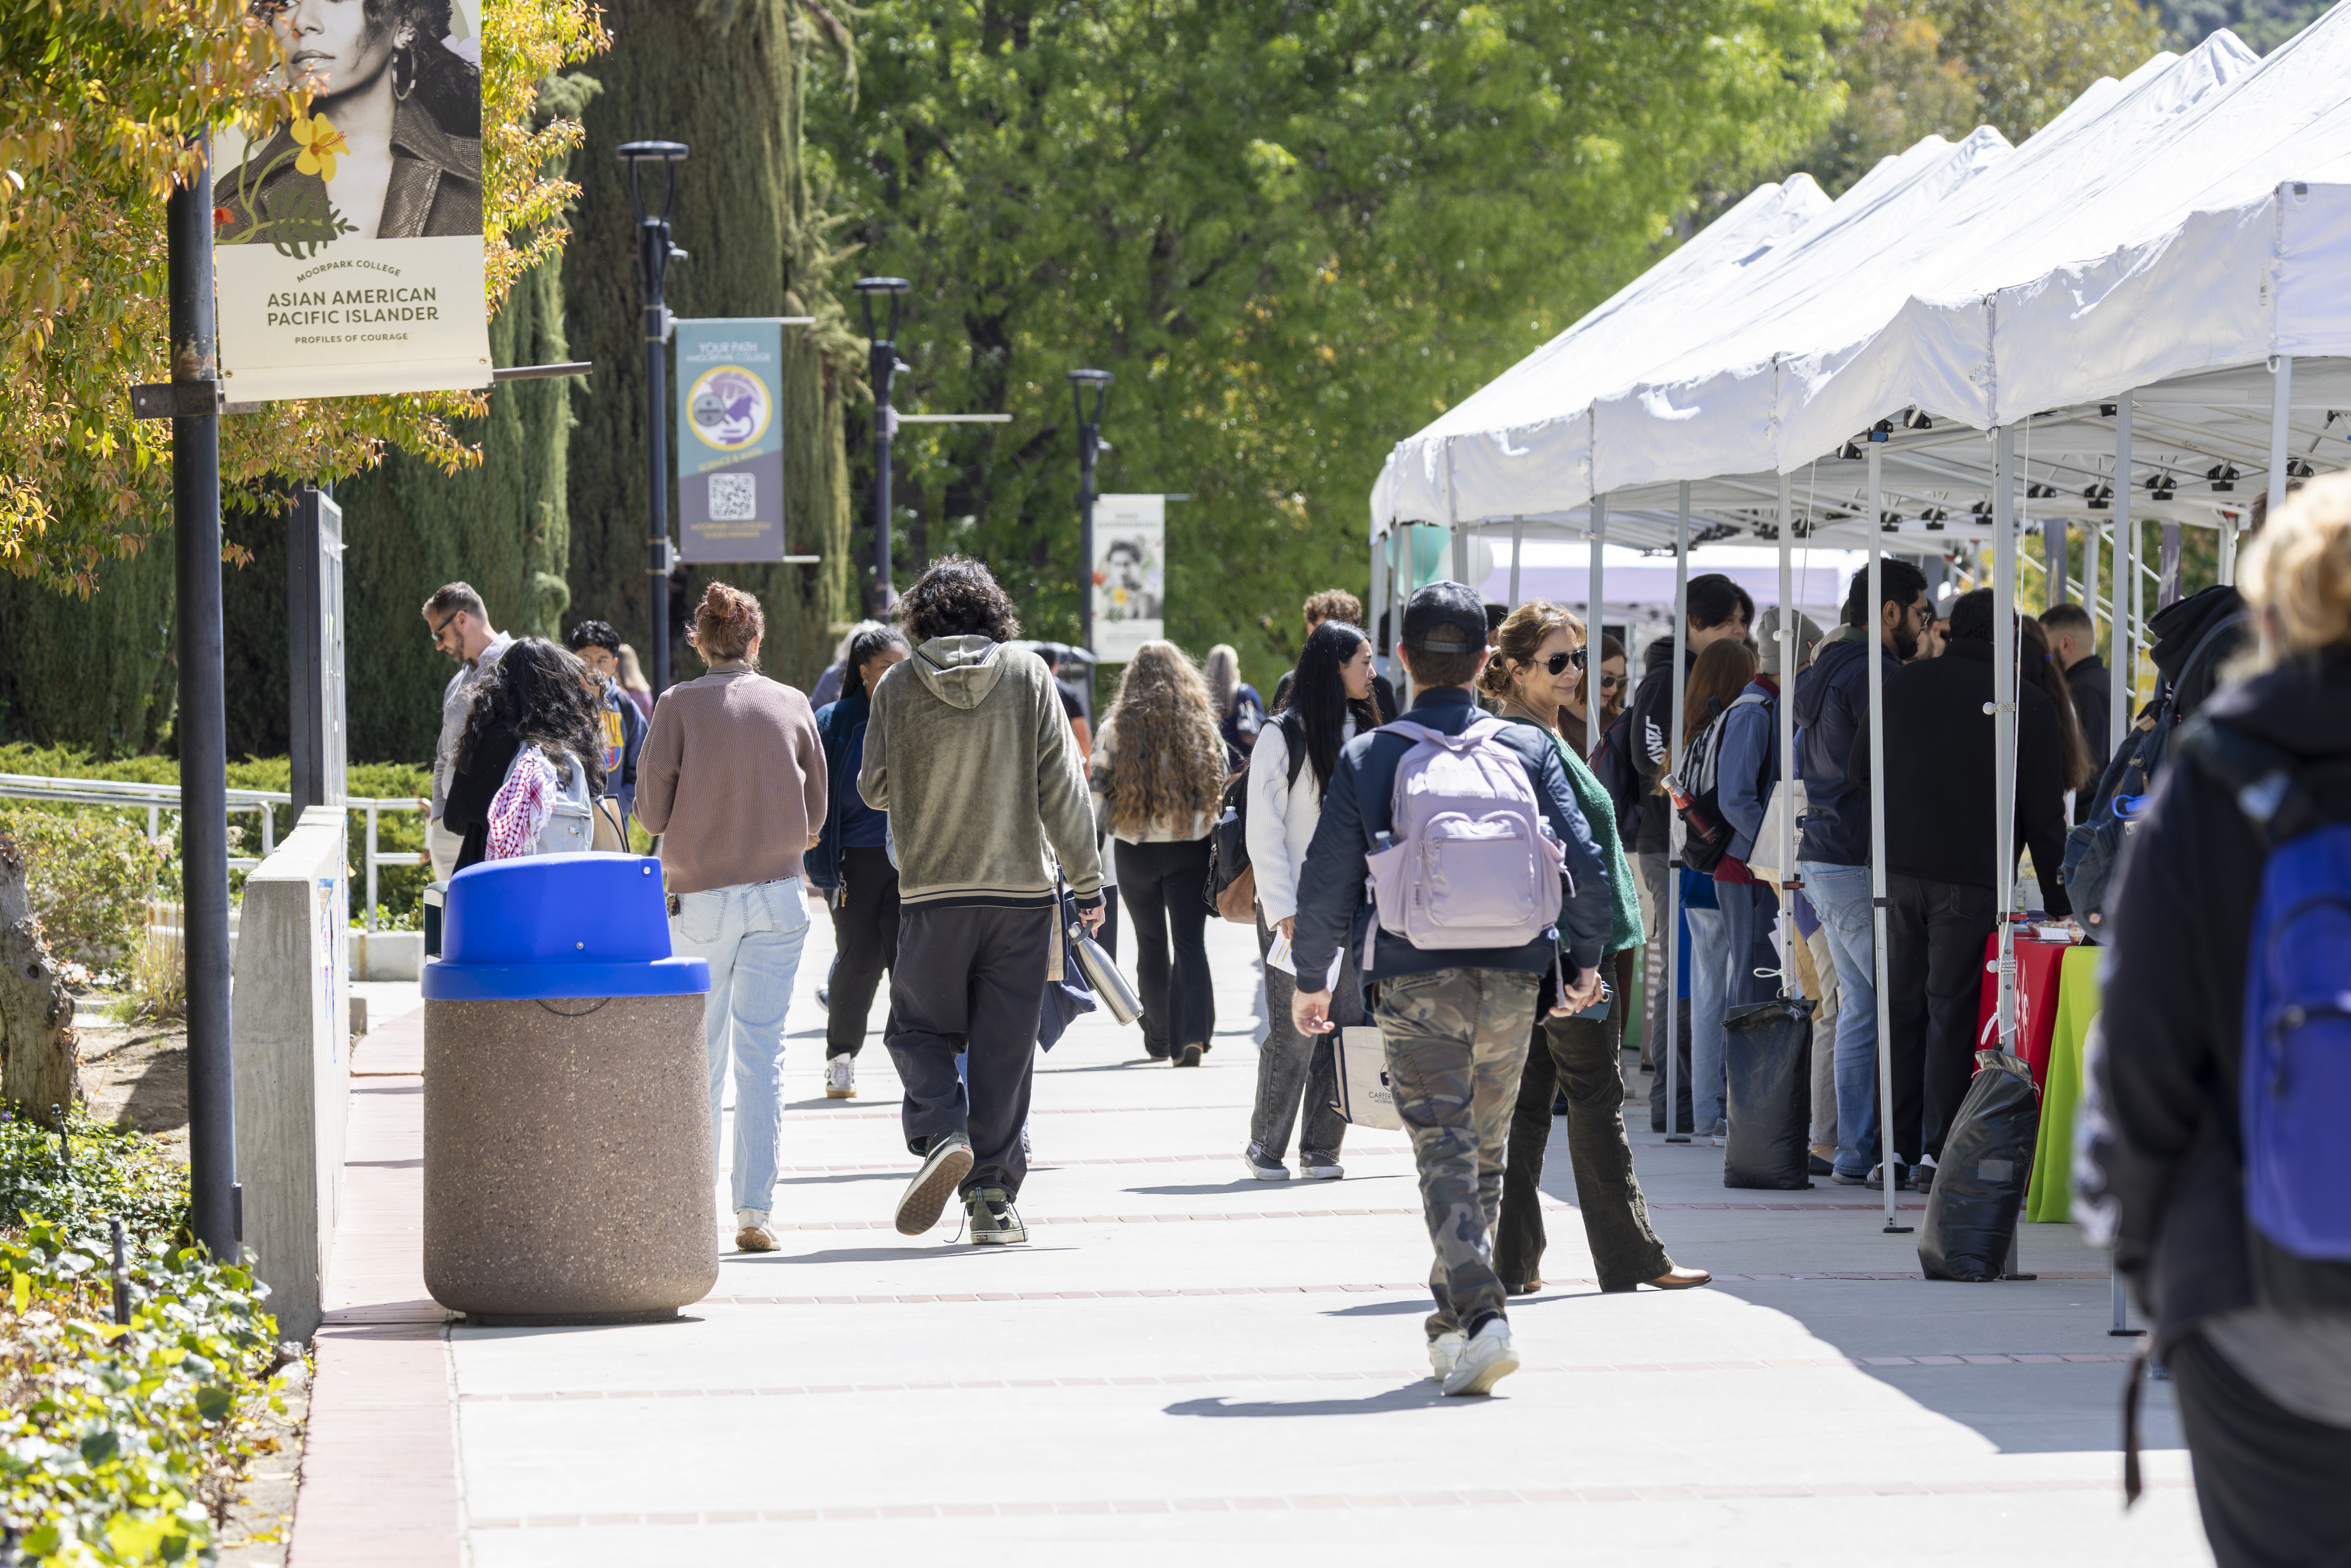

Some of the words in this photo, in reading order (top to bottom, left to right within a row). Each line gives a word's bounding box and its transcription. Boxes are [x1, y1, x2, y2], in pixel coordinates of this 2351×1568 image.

[297, 260, 353, 283] MOORPARK
[356, 260, 401, 277] COLLEGE
[267, 292, 326, 307] ASIAN
[332, 287, 436, 305] AMERICAN
[268, 310, 339, 326] PACIFIC
[346, 306, 439, 323] ISLANDER
[295, 335, 342, 344] PROFILES
[361, 333, 408, 341] COURAGE
[698, 341, 729, 353] YOUR
[731, 341, 757, 352] PATH
[1368, 1091, 1391, 1100] CAREER
